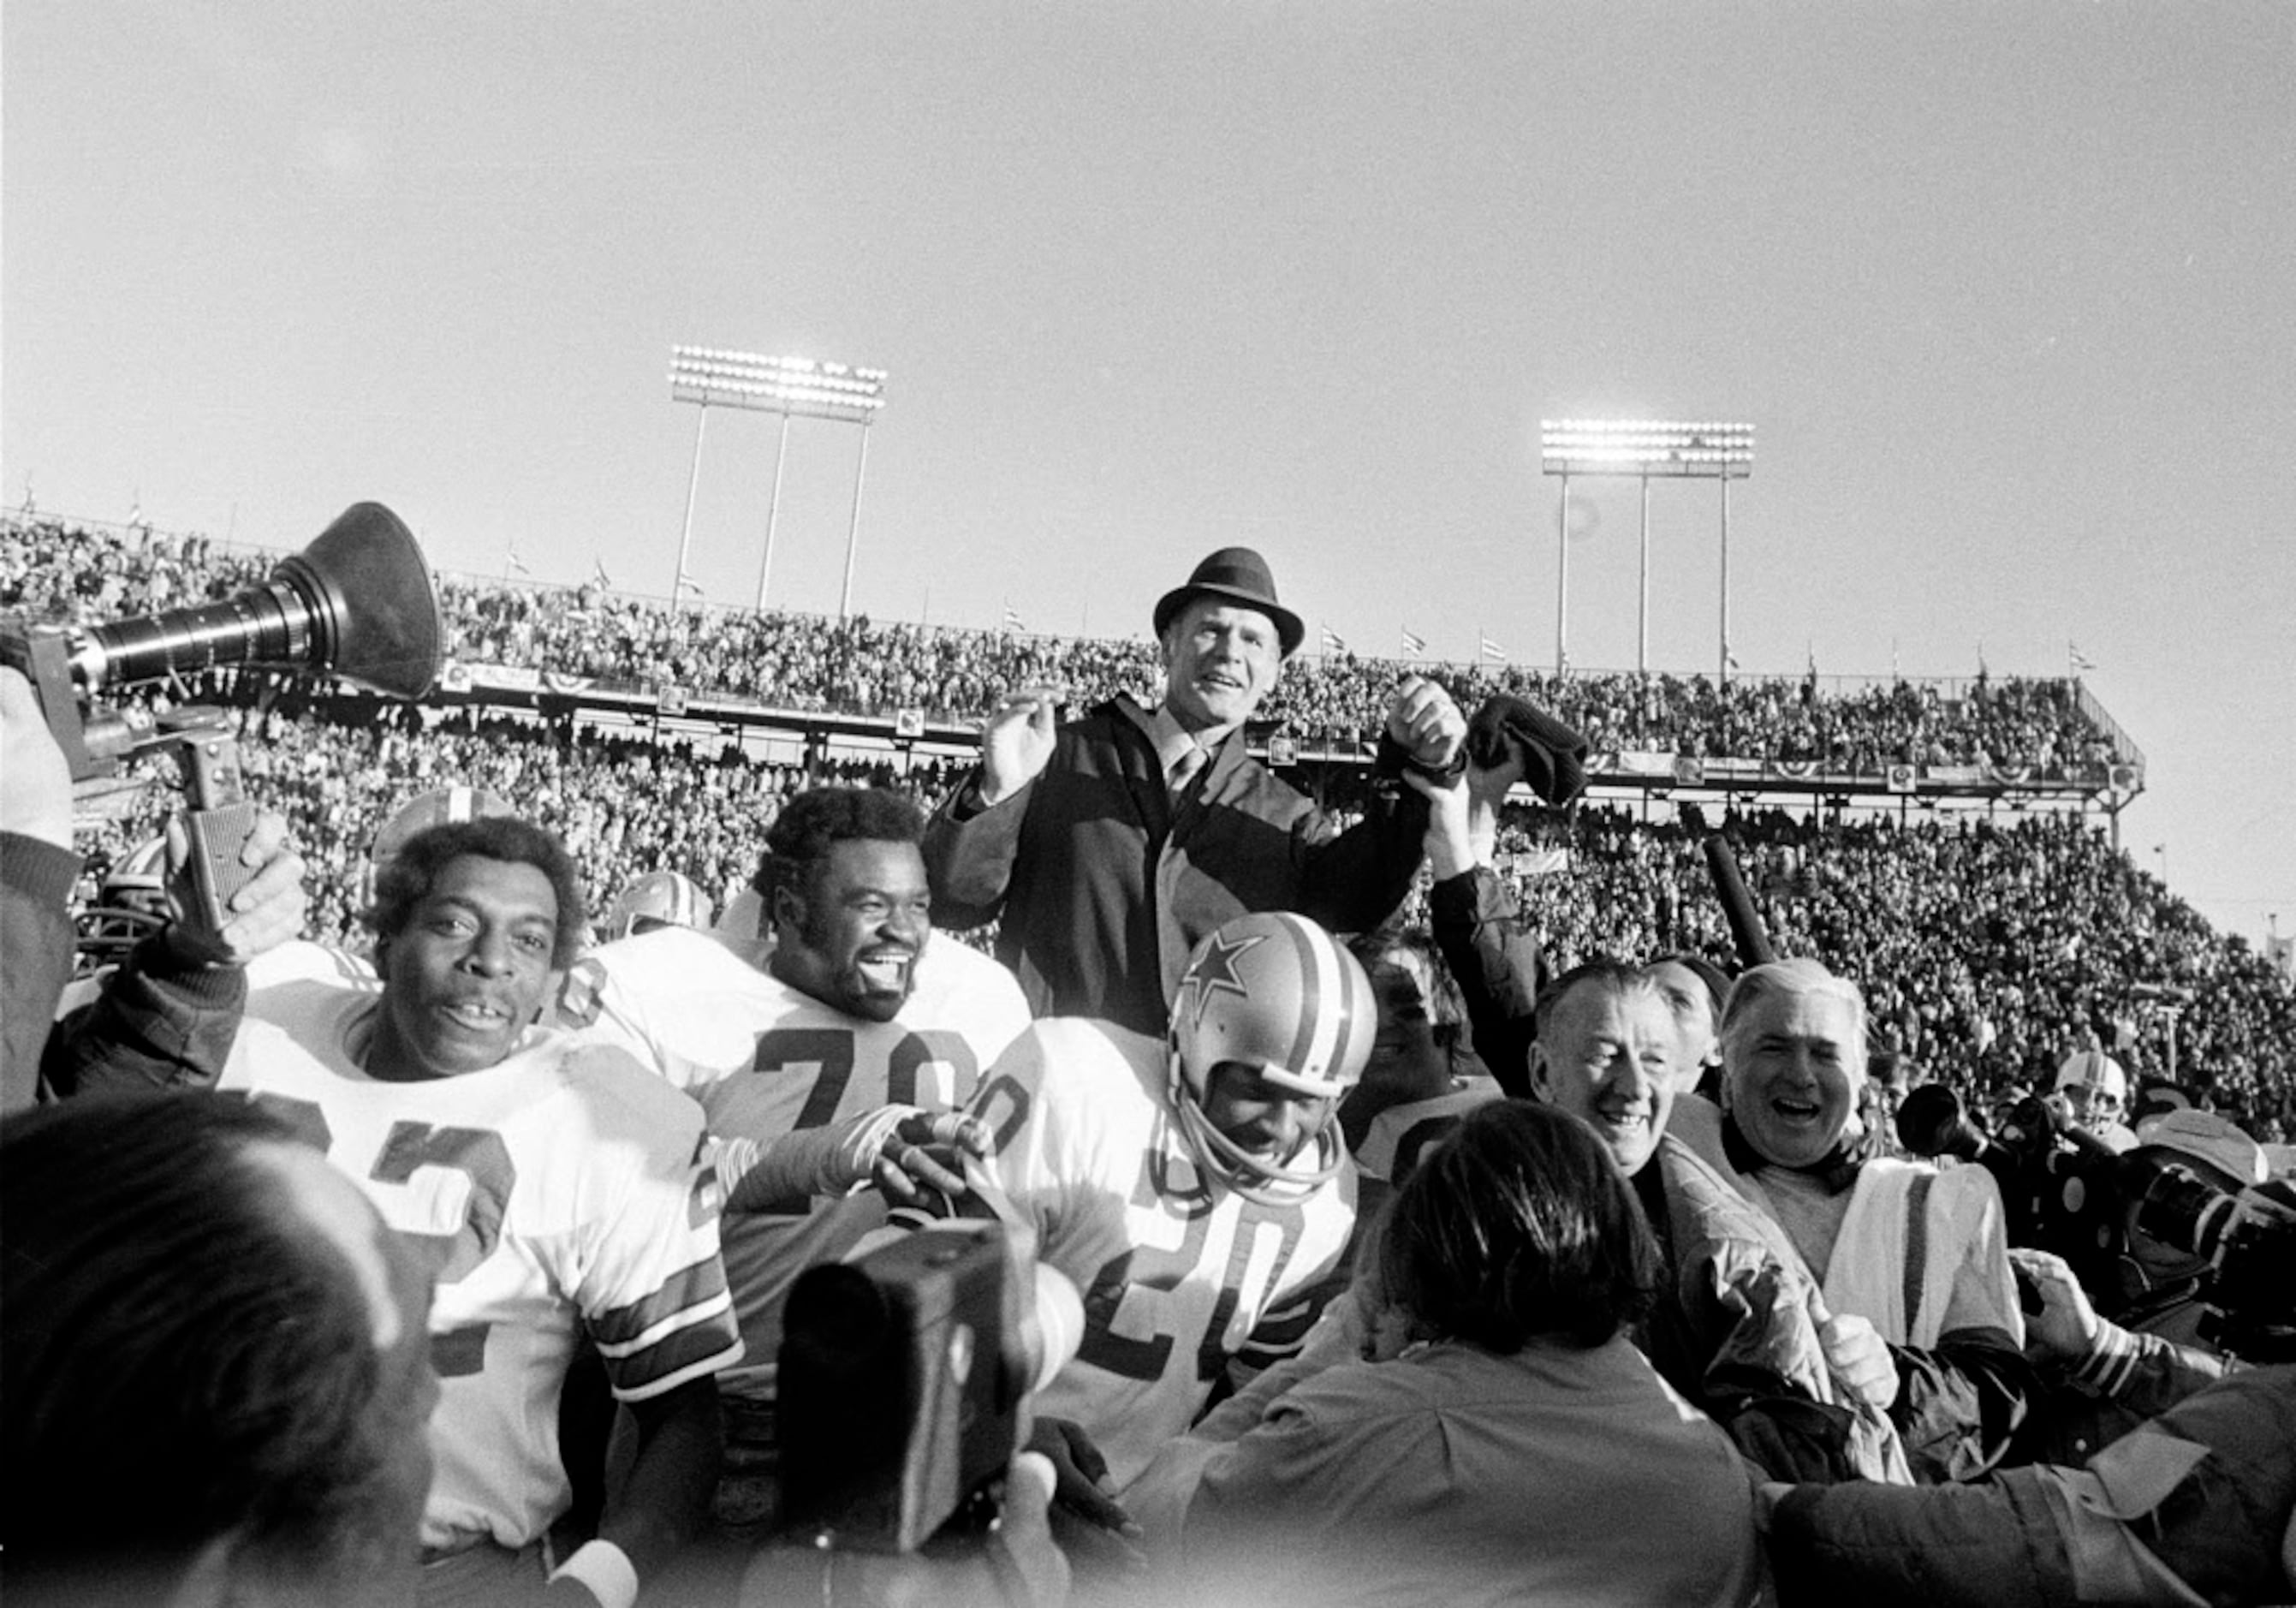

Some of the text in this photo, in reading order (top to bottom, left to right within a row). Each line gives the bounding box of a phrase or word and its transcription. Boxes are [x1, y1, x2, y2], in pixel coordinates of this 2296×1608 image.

[964, 1069, 1031, 1157] 0
[212, 1088, 517, 1379] 2
[1075, 1146, 1306, 1382] 20
